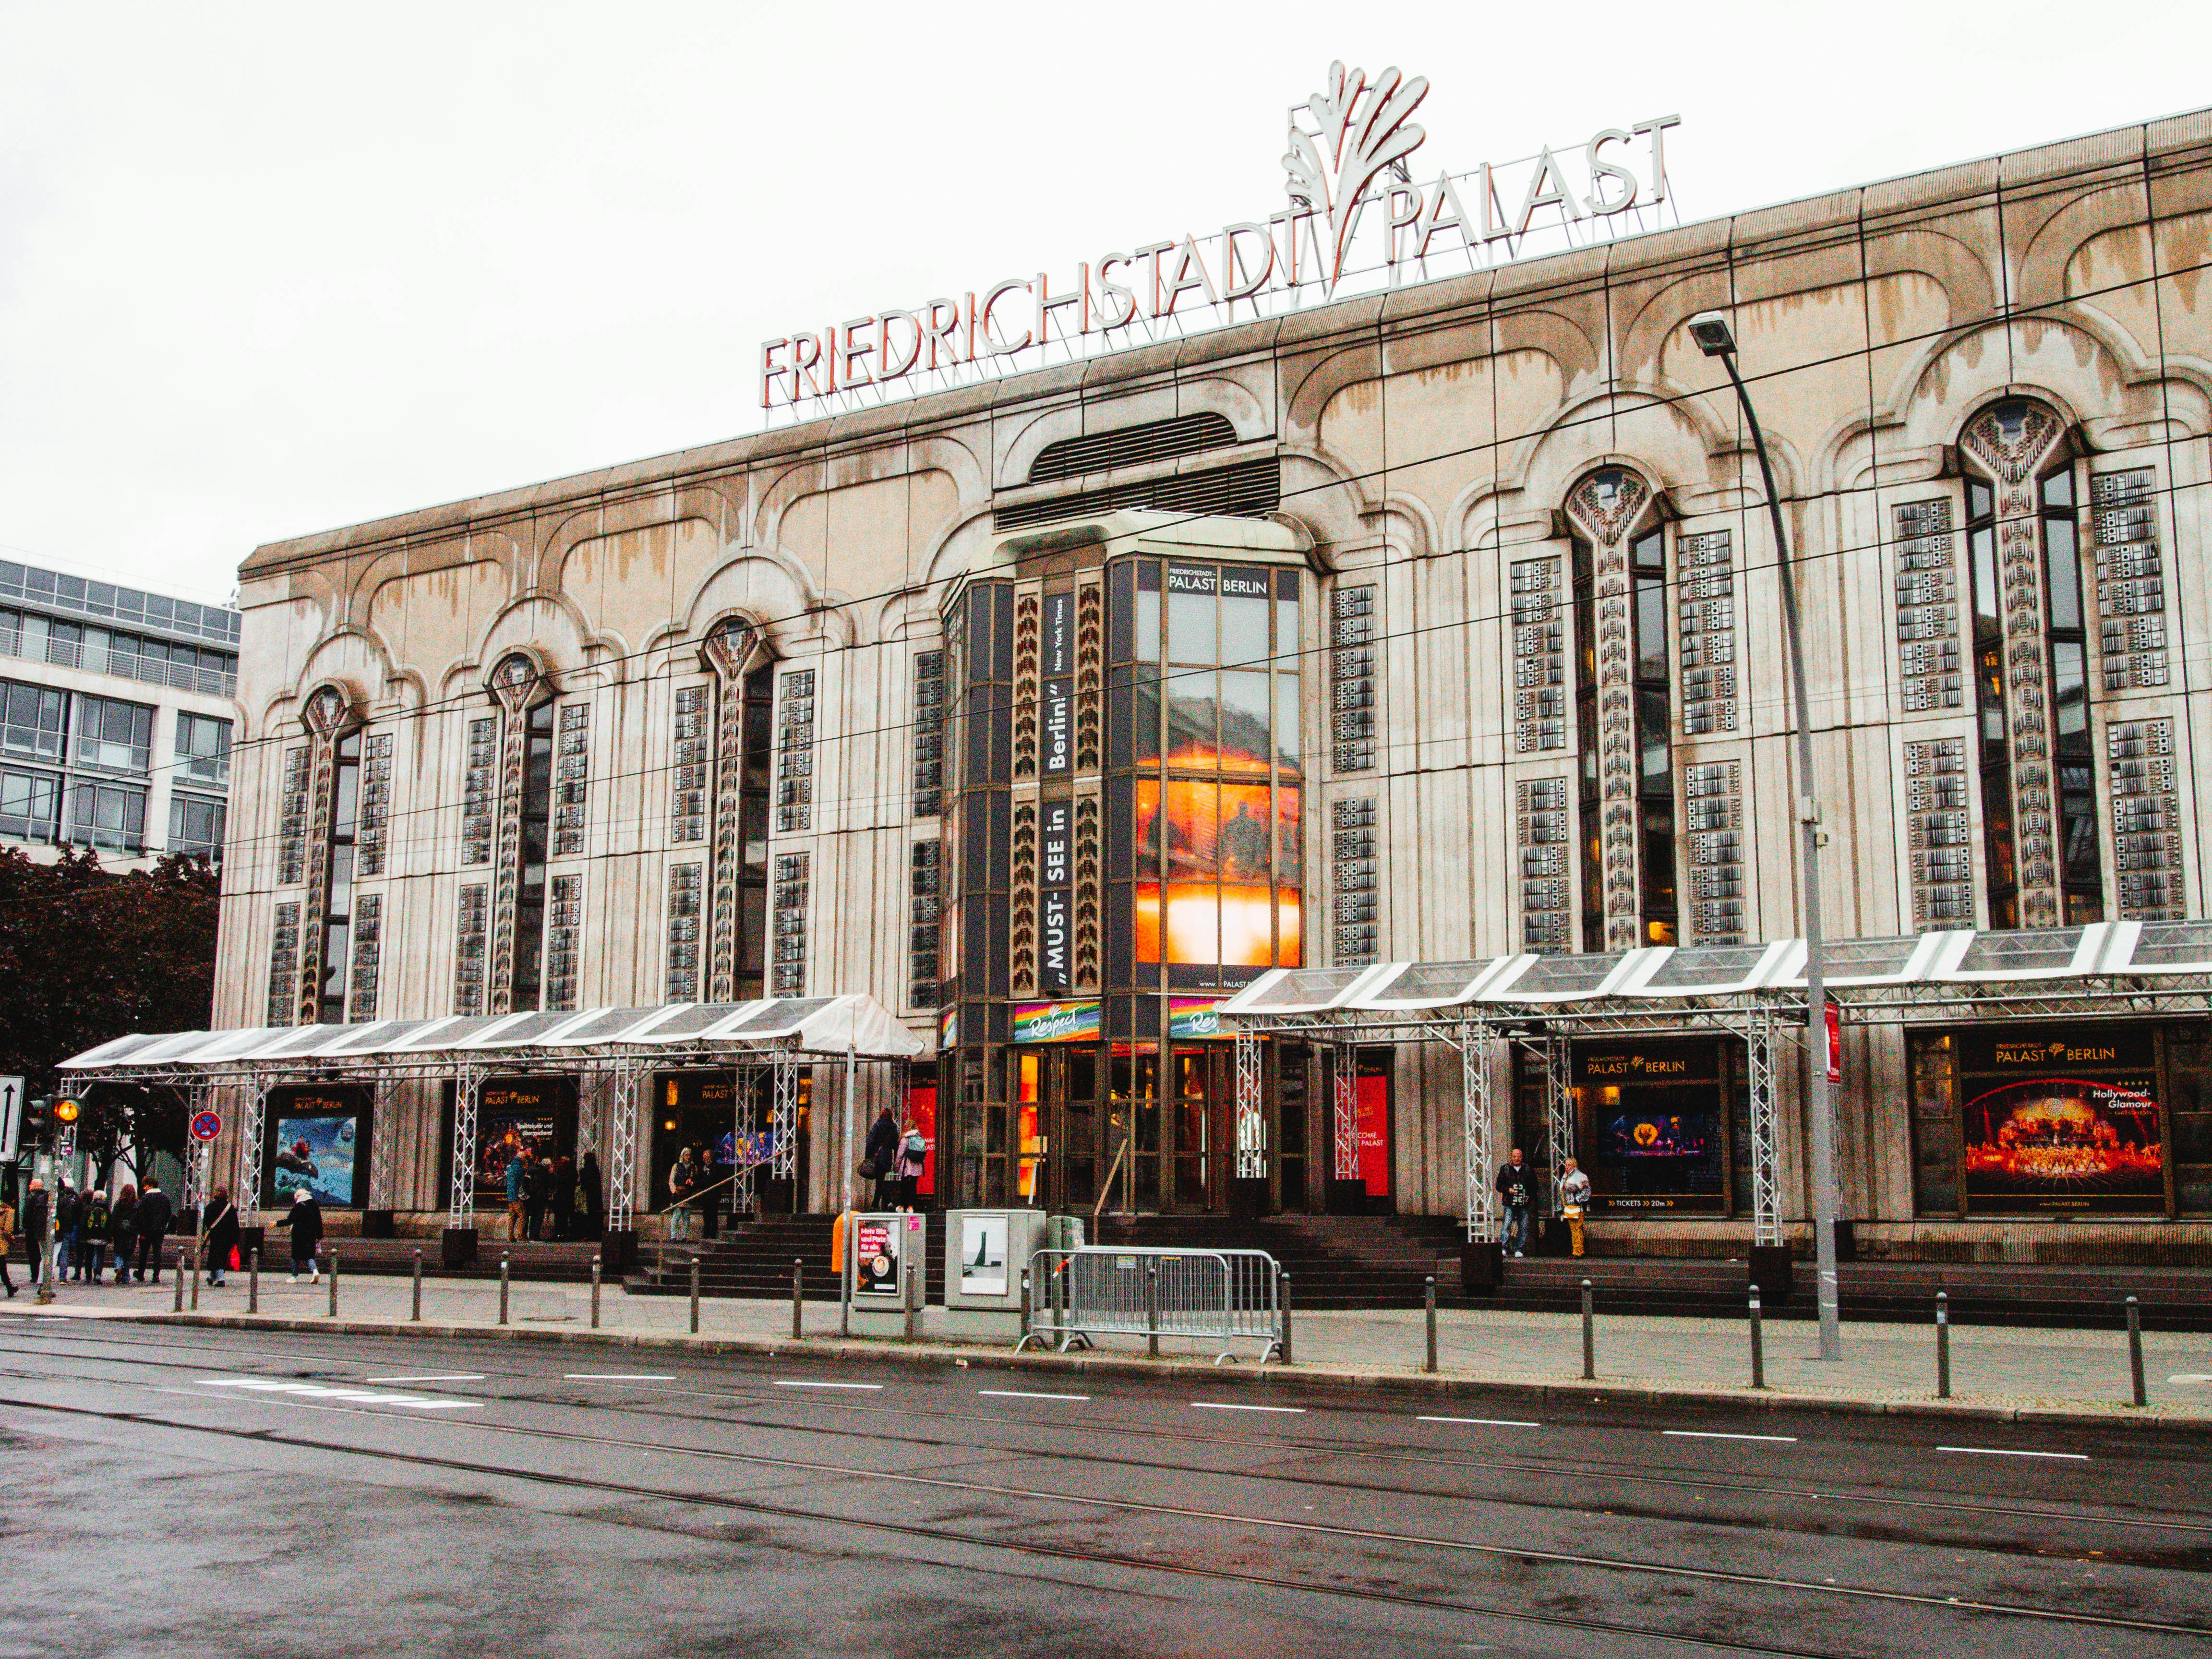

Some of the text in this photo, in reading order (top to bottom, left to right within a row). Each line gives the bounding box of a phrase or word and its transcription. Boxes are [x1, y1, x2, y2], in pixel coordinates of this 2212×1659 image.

[759, 114, 1681, 408] FRIEDRICHSTADT PALAST
[1169, 576, 1267, 593] PALAST BERLIN
[1047, 809, 1064, 831] in
[1029, 1004, 1082, 1037] Respect
[1996, 1047, 2115, 1063] PALAST BERLIN
[1588, 1061, 1684, 1074] PALAST BERLIN
[702, 1089, 728, 1098] PALAST
[2093, 1088, 2151, 1100] Hollywood-
[2108, 1099, 2152, 1108] Glamour
